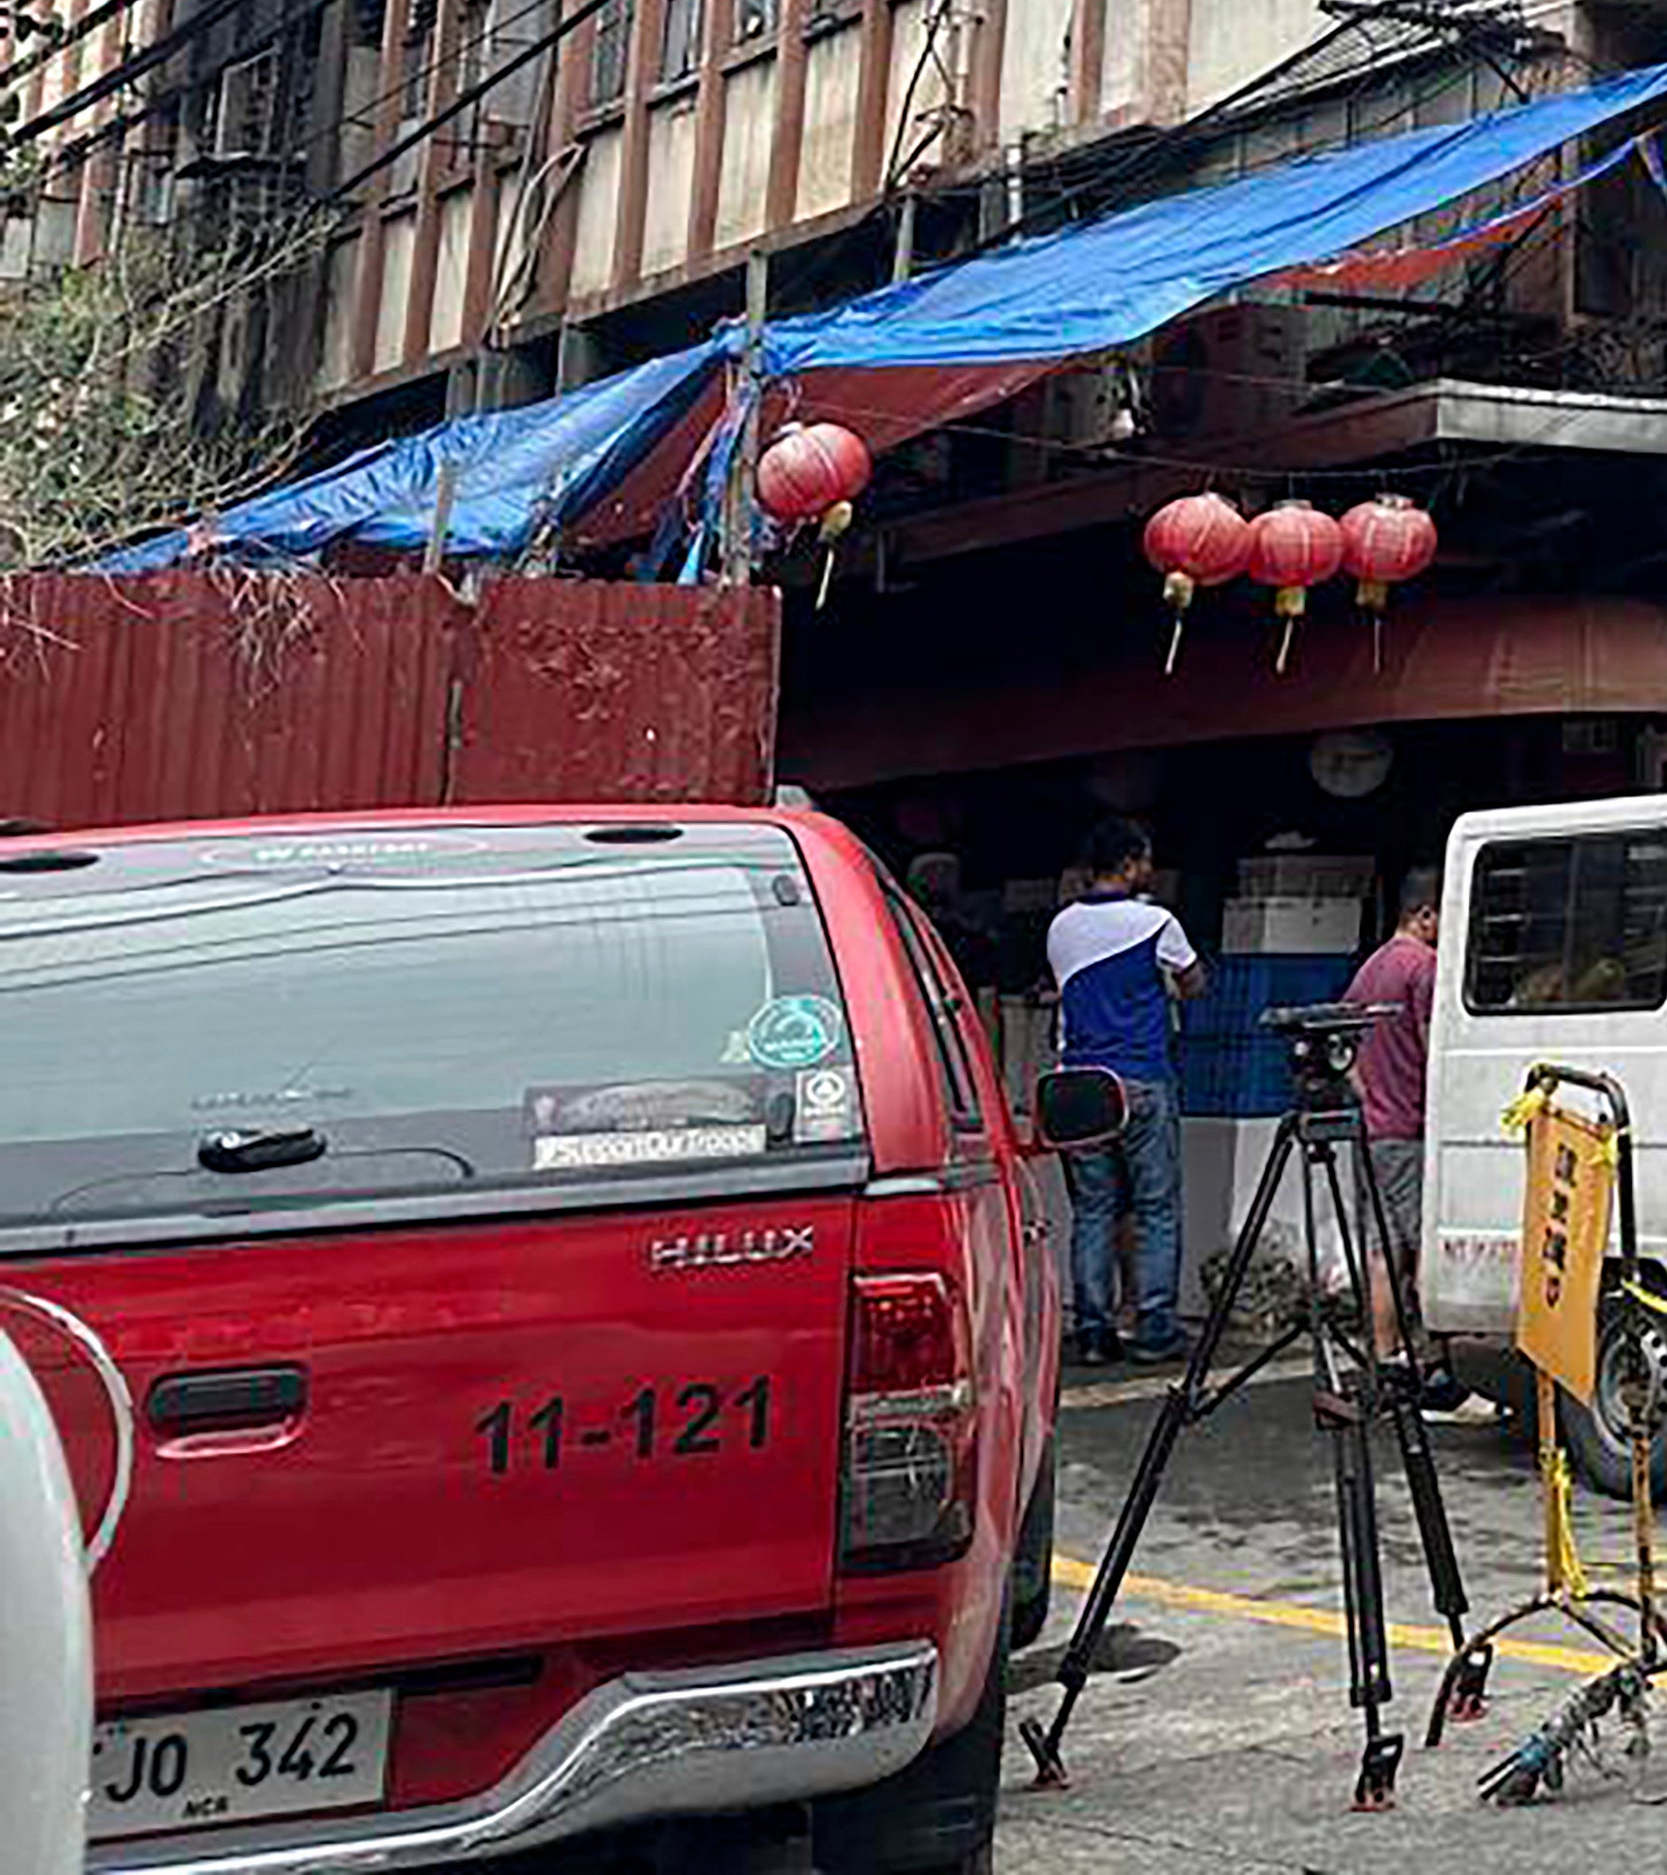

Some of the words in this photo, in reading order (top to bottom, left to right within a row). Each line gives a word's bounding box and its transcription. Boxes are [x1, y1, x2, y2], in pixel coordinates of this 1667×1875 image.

[650, 1226, 814, 1271] HILUX
[474, 1375, 771, 1475] 11-121
[95, 1731, 189, 1794] JO
[236, 1712, 356, 1787] 342
